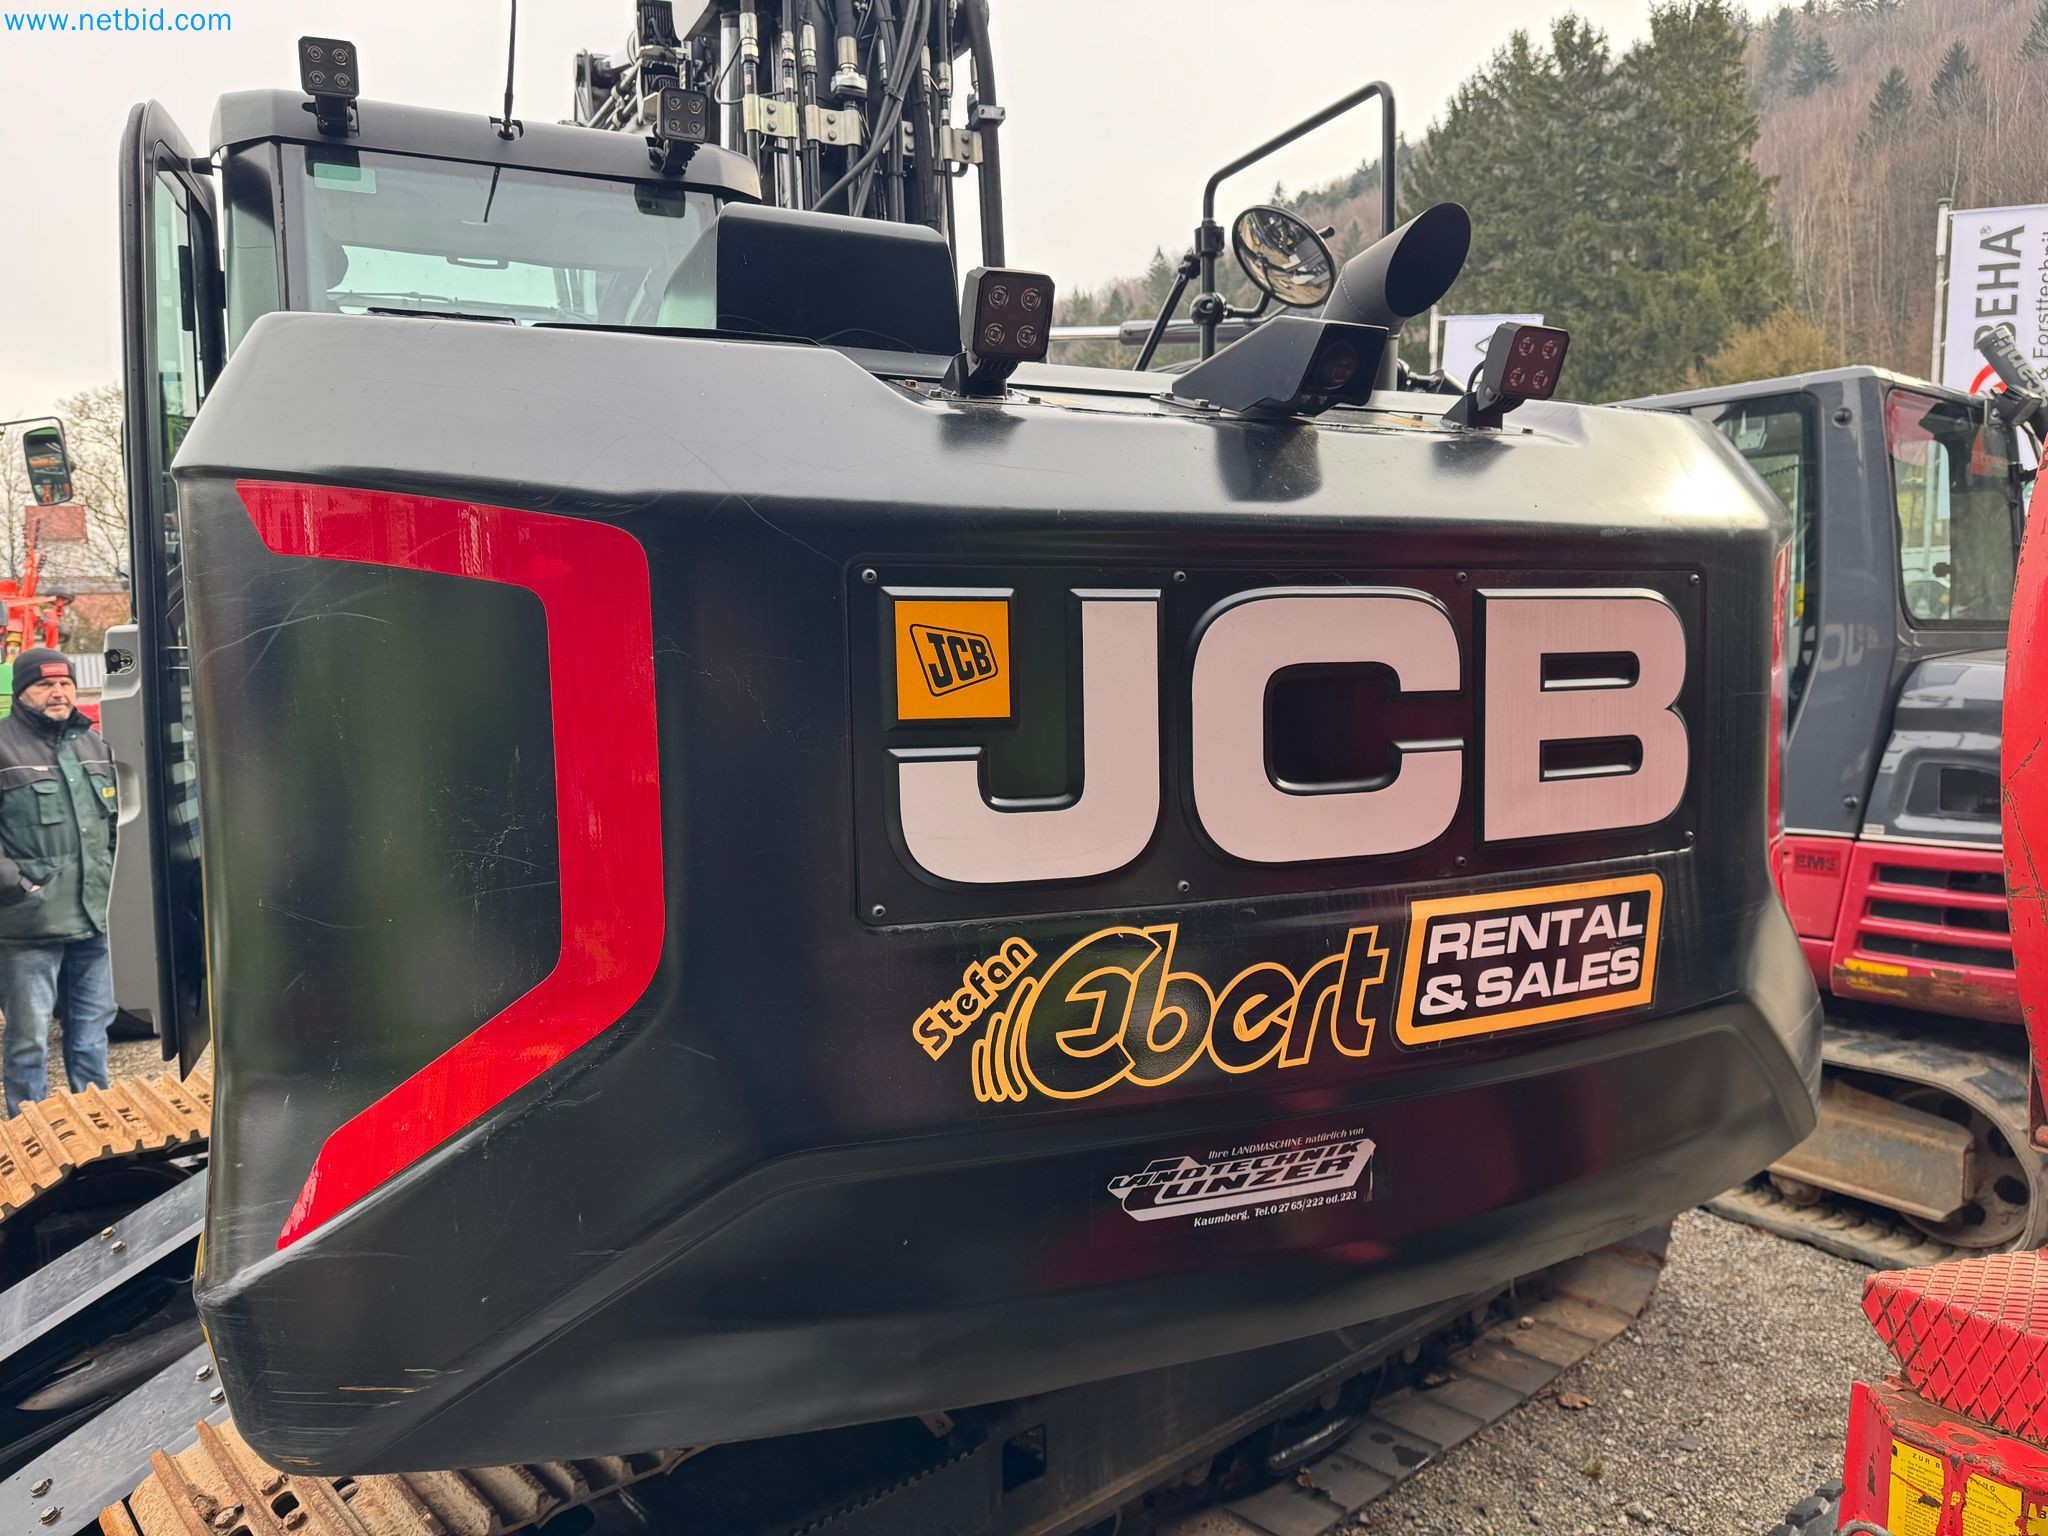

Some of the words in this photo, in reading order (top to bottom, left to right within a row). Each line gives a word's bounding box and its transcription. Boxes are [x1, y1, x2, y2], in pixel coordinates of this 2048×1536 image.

[926, 632, 993, 689] JCB
[890, 587, 1690, 884] JCB
[1427, 901, 1643, 965] RENTAL
[913, 936, 1038, 1062] Stefan
[1018, 924, 1390, 1100] Ebert
[1419, 974, 1468, 1016] &
[1475, 946, 1640, 1008] SALES
[1108, 1140, 1368, 1190] LANDTECHNIK
[1208, 1150, 1230, 1160] Ihre
[1231, 1136, 1303, 1156] LANDMASCHINE
[1305, 1129, 1348, 1144] natürlich
[1349, 1127, 1365, 1136] von
